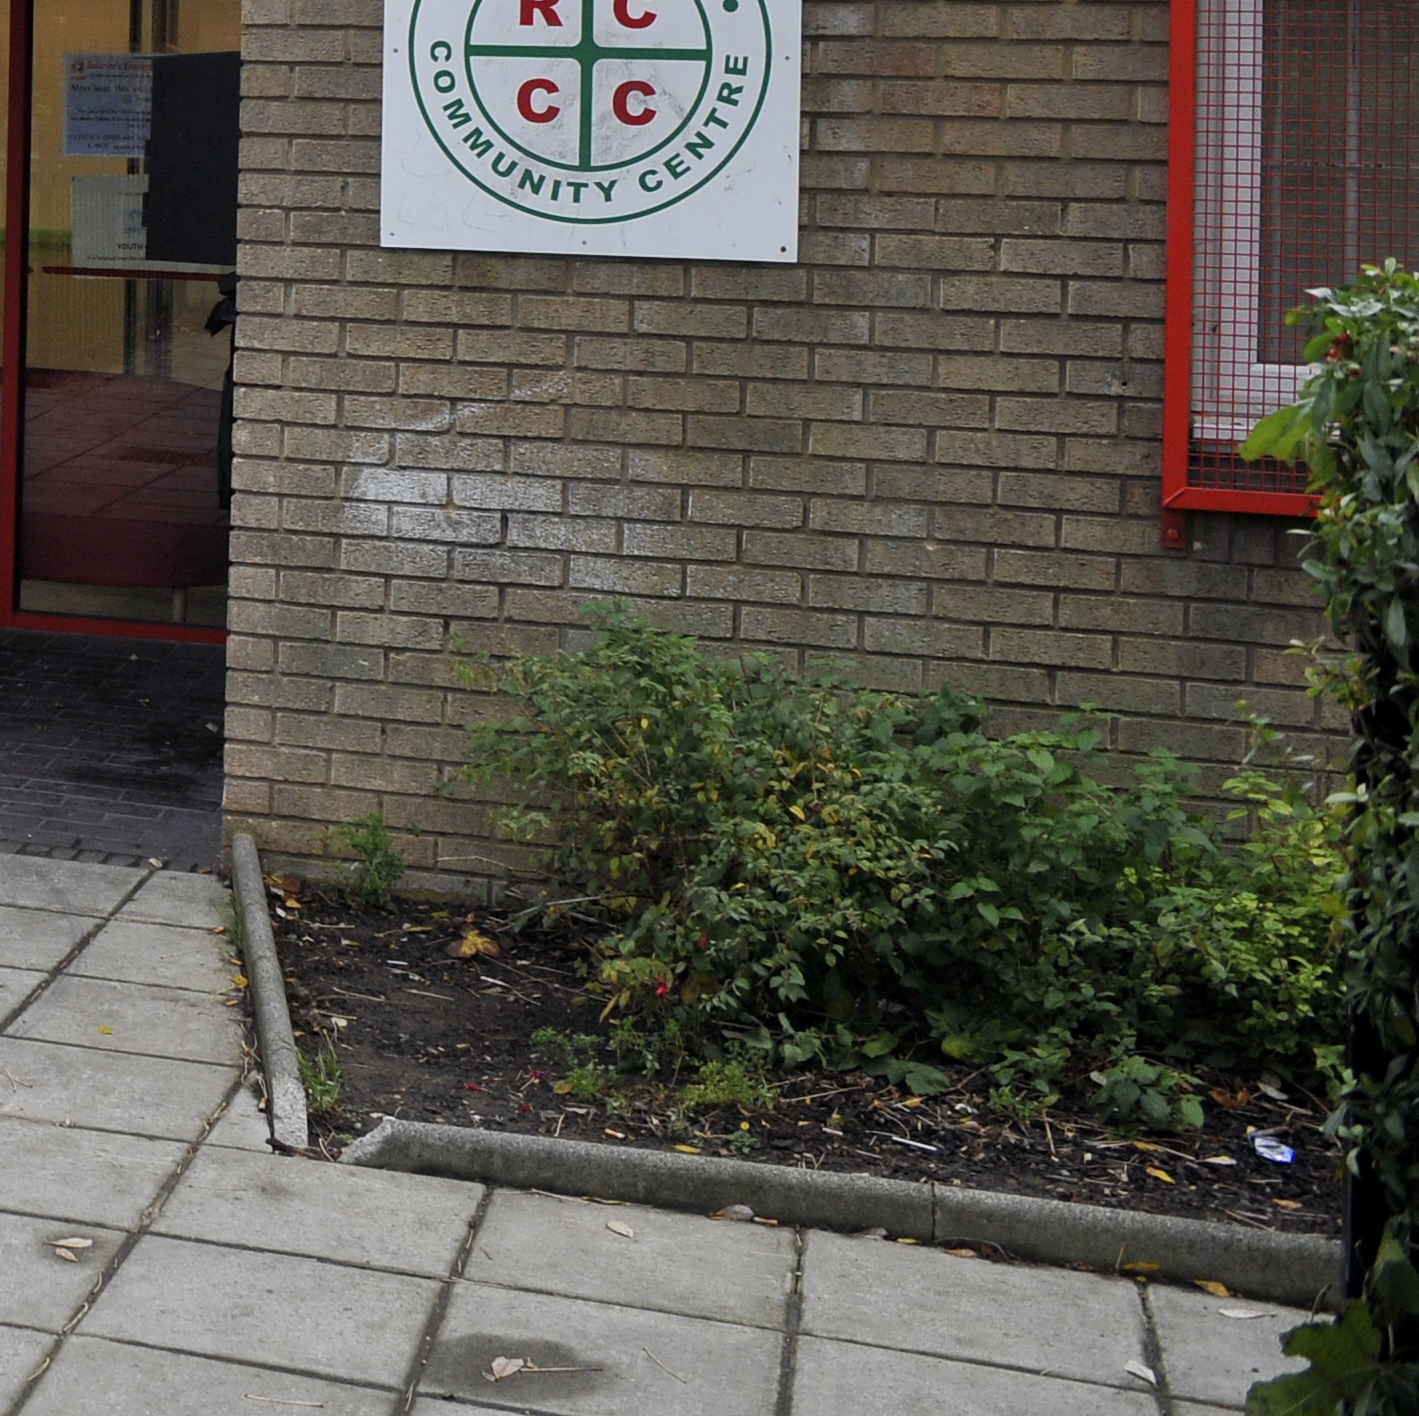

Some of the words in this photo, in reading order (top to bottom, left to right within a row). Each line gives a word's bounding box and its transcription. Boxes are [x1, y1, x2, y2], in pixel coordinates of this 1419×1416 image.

[429, 40, 618, 203] COMMUNITY
[638, 54, 749, 193] CENTRE
[517, 78, 561, 123] C
[613, 80, 657, 125] C
